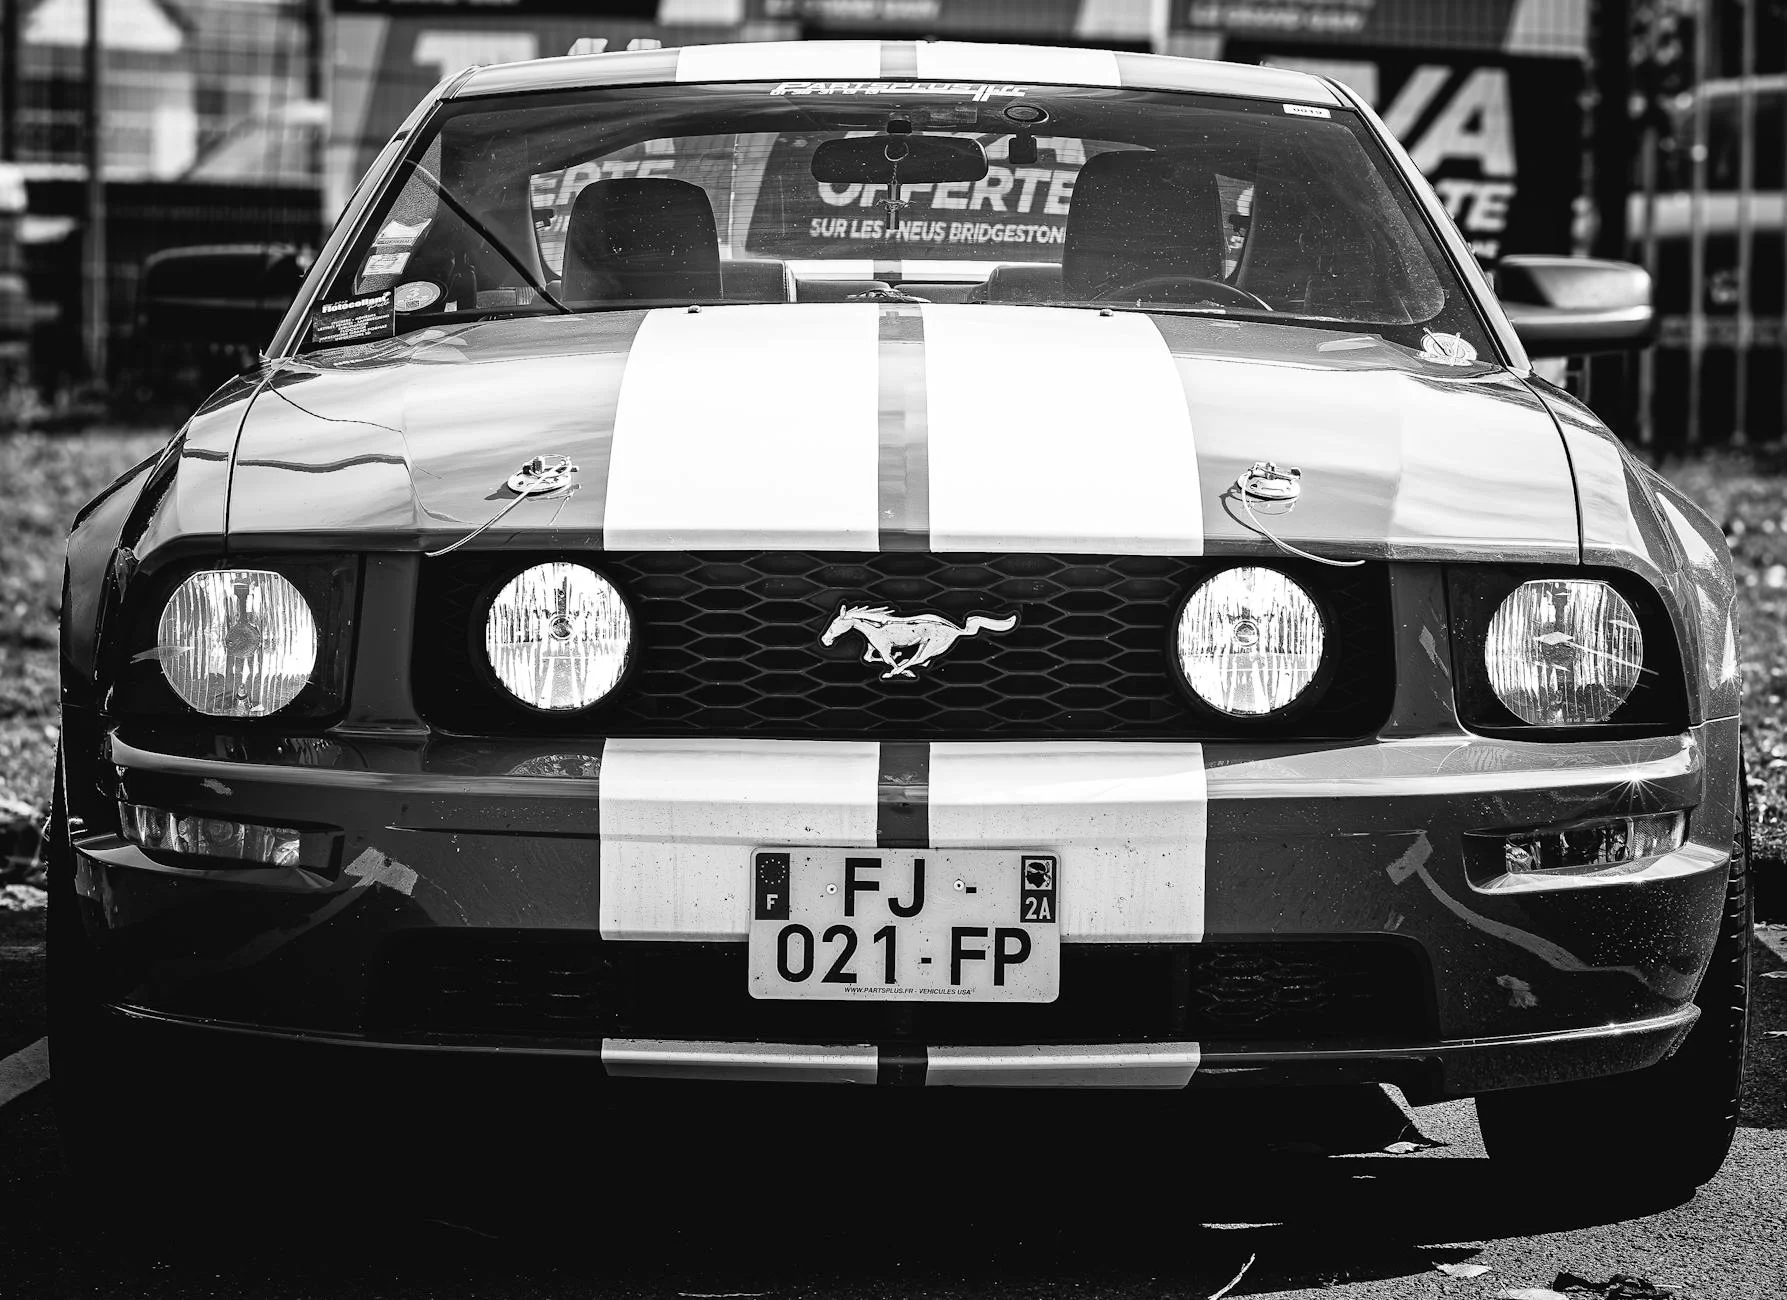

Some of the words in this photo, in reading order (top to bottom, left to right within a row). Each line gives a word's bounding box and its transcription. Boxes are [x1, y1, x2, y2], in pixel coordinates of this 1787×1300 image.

[818, 165, 1079, 215] OERTE
[810, 218, 847, 237] SUR
[850, 219, 884, 239] LES
[885, 221, 947, 242] NEUS
[949, 223, 1066, 244] BRIDGESTON
[844, 857, 926, 918] FJ
[766, 893, 778, 910] F
[1024, 896, 1051, 920] 2A
[777, 923, 897, 985] 021
[951, 926, 1032, 987] FP
[844, 986, 914, 995] WWW.PARTSPLUS.FR
[957, 988, 972, 996] USA
